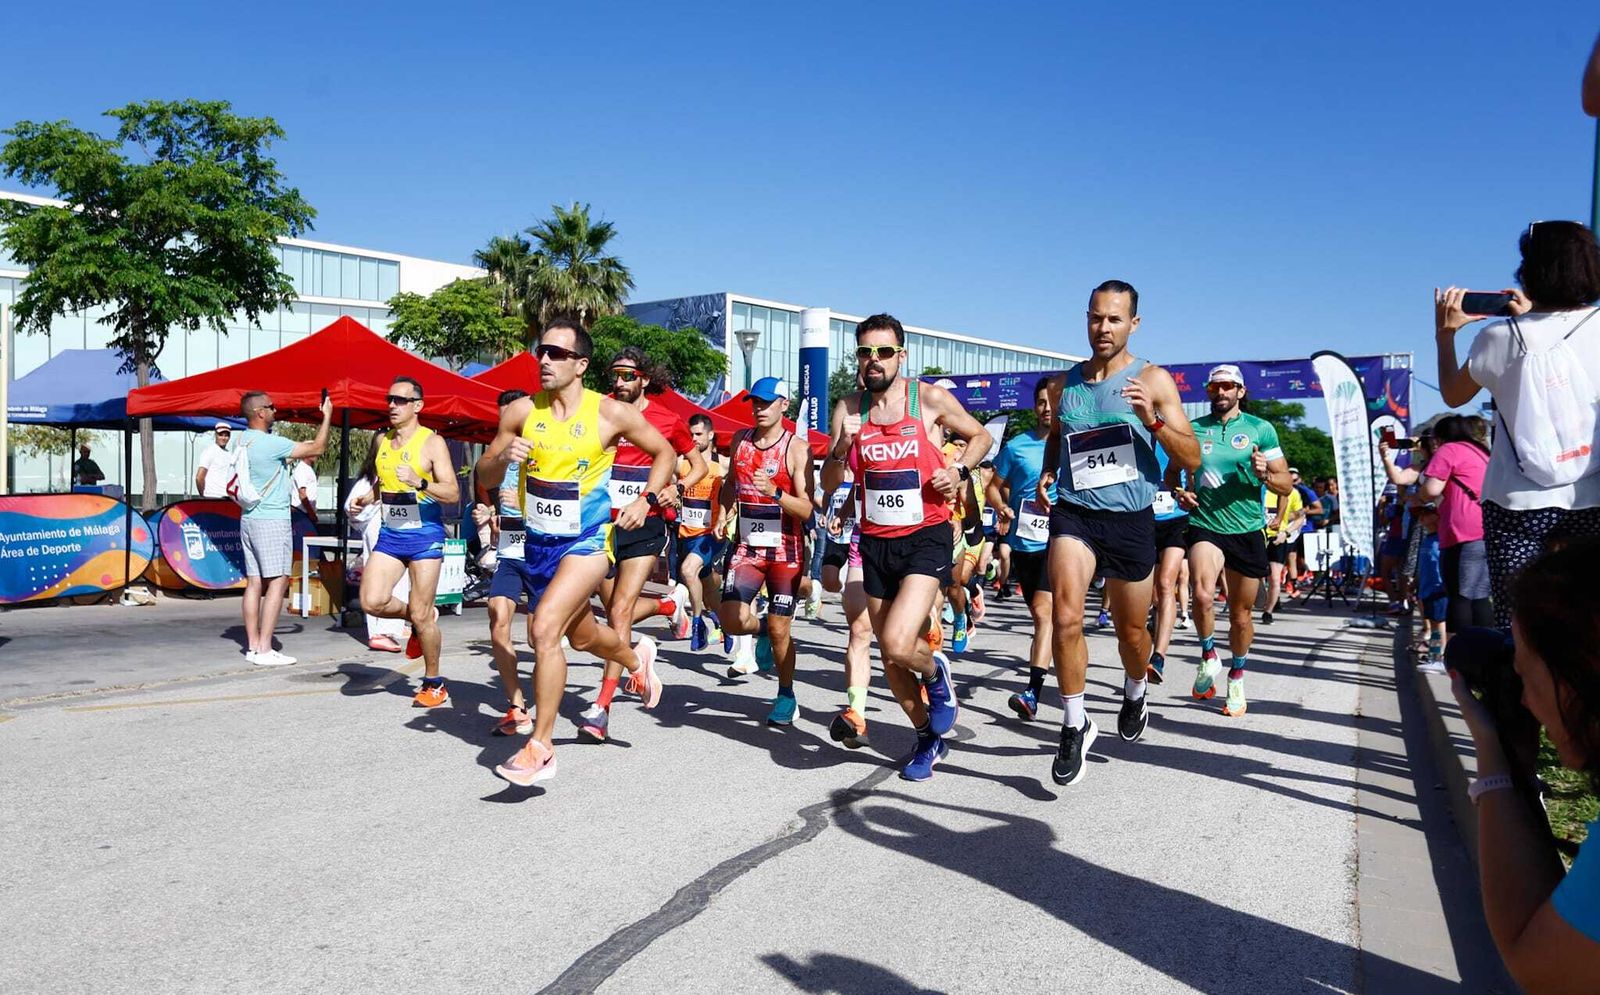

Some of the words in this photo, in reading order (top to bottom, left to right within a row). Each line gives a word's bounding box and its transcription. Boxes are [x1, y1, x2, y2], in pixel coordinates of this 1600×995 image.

[811, 421, 818, 430] LA
[861, 439, 919, 462] KENYA
[1087, 451, 1117, 469] 514
[618, 484, 641, 496] 464
[877, 494, 905, 508] 486
[389, 507, 408, 517] 643
[536, 501, 562, 517] 646
[688, 510, 703, 518] 310
[750, 522, 765, 533] 28
[0, 529, 67, 544] Ayuntamiento
[68, 527, 82, 537] de
[83, 524, 121, 536] Málaga
[509, 533, 527, 544] 399
[0, 546, 25, 558] Área
[26, 546, 40, 556] de
[41, 542, 82, 556] Deporte
[205, 540, 224, 551] Área
[224, 543, 235, 551] de
